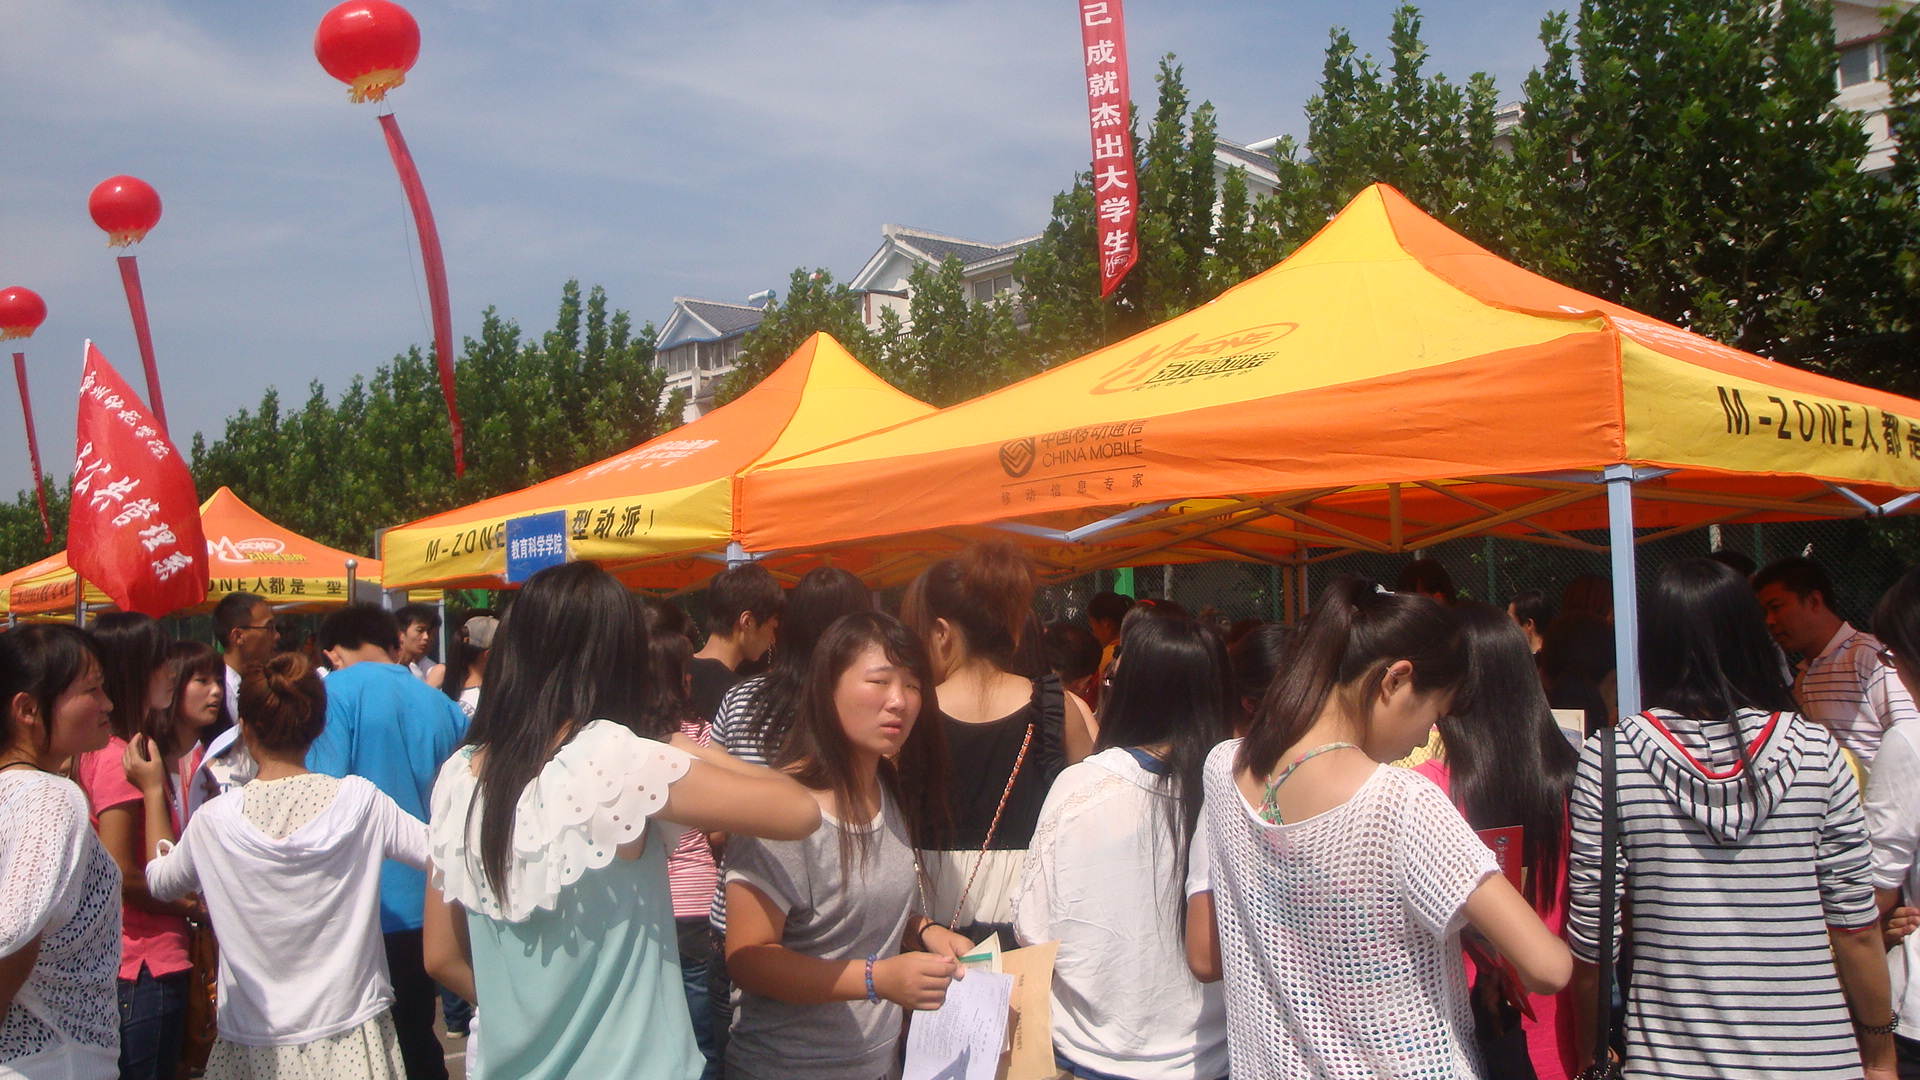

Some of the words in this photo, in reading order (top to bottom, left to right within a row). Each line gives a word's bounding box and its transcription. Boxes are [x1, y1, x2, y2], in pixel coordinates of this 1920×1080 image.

[1086, 40, 1131, 256] 成就杰出大学生
[1041, 420, 1146, 449] 中国移动通信
[1042, 446, 1087, 468] CHINA
[1090, 439, 1143, 461] MOBILE
[1001, 473, 1144, 505] 移动信息专家
[511, 533, 562, 560] 教育科学学院
